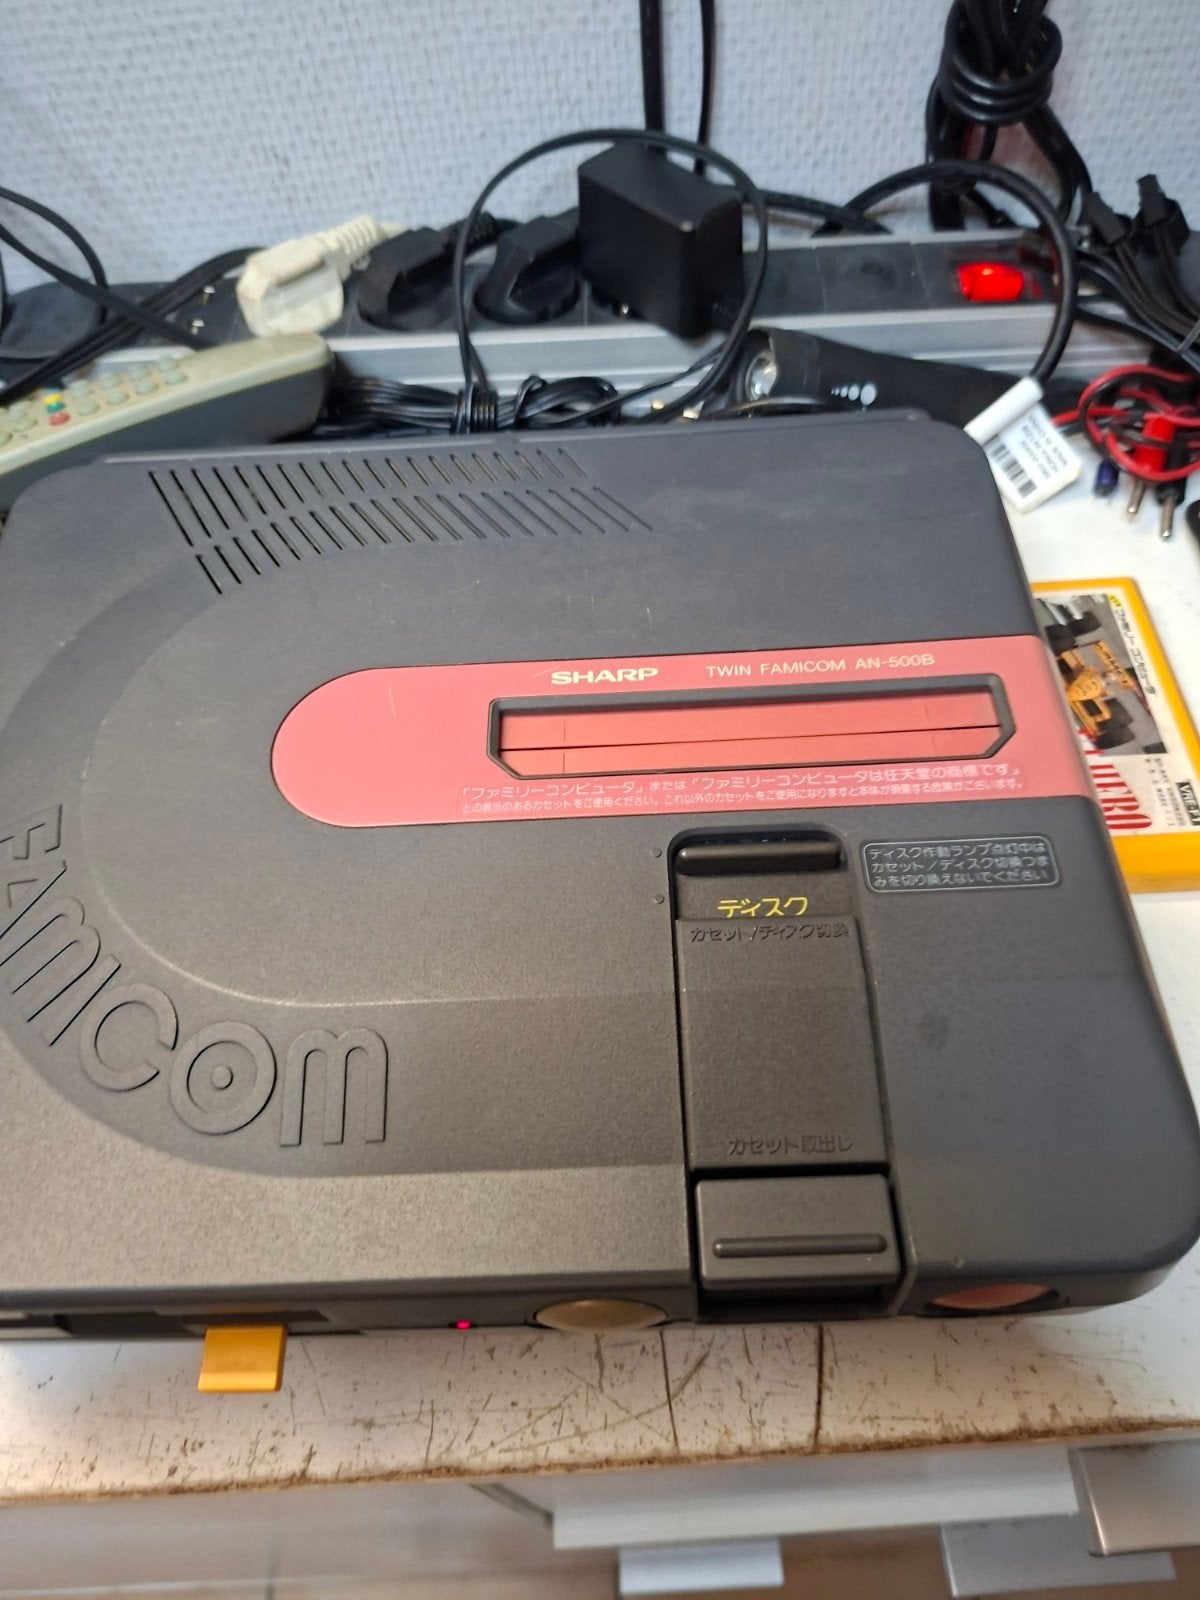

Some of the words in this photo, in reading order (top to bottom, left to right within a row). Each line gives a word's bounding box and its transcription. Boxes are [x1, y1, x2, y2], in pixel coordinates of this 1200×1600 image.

[551, 667, 659, 685] SHARP
[706, 664, 752, 678] TWIN
[760, 659, 846, 675] FAMICOM
[855, 653, 935, 670] AN-500B
[717, 896, 809, 919] ディスク
